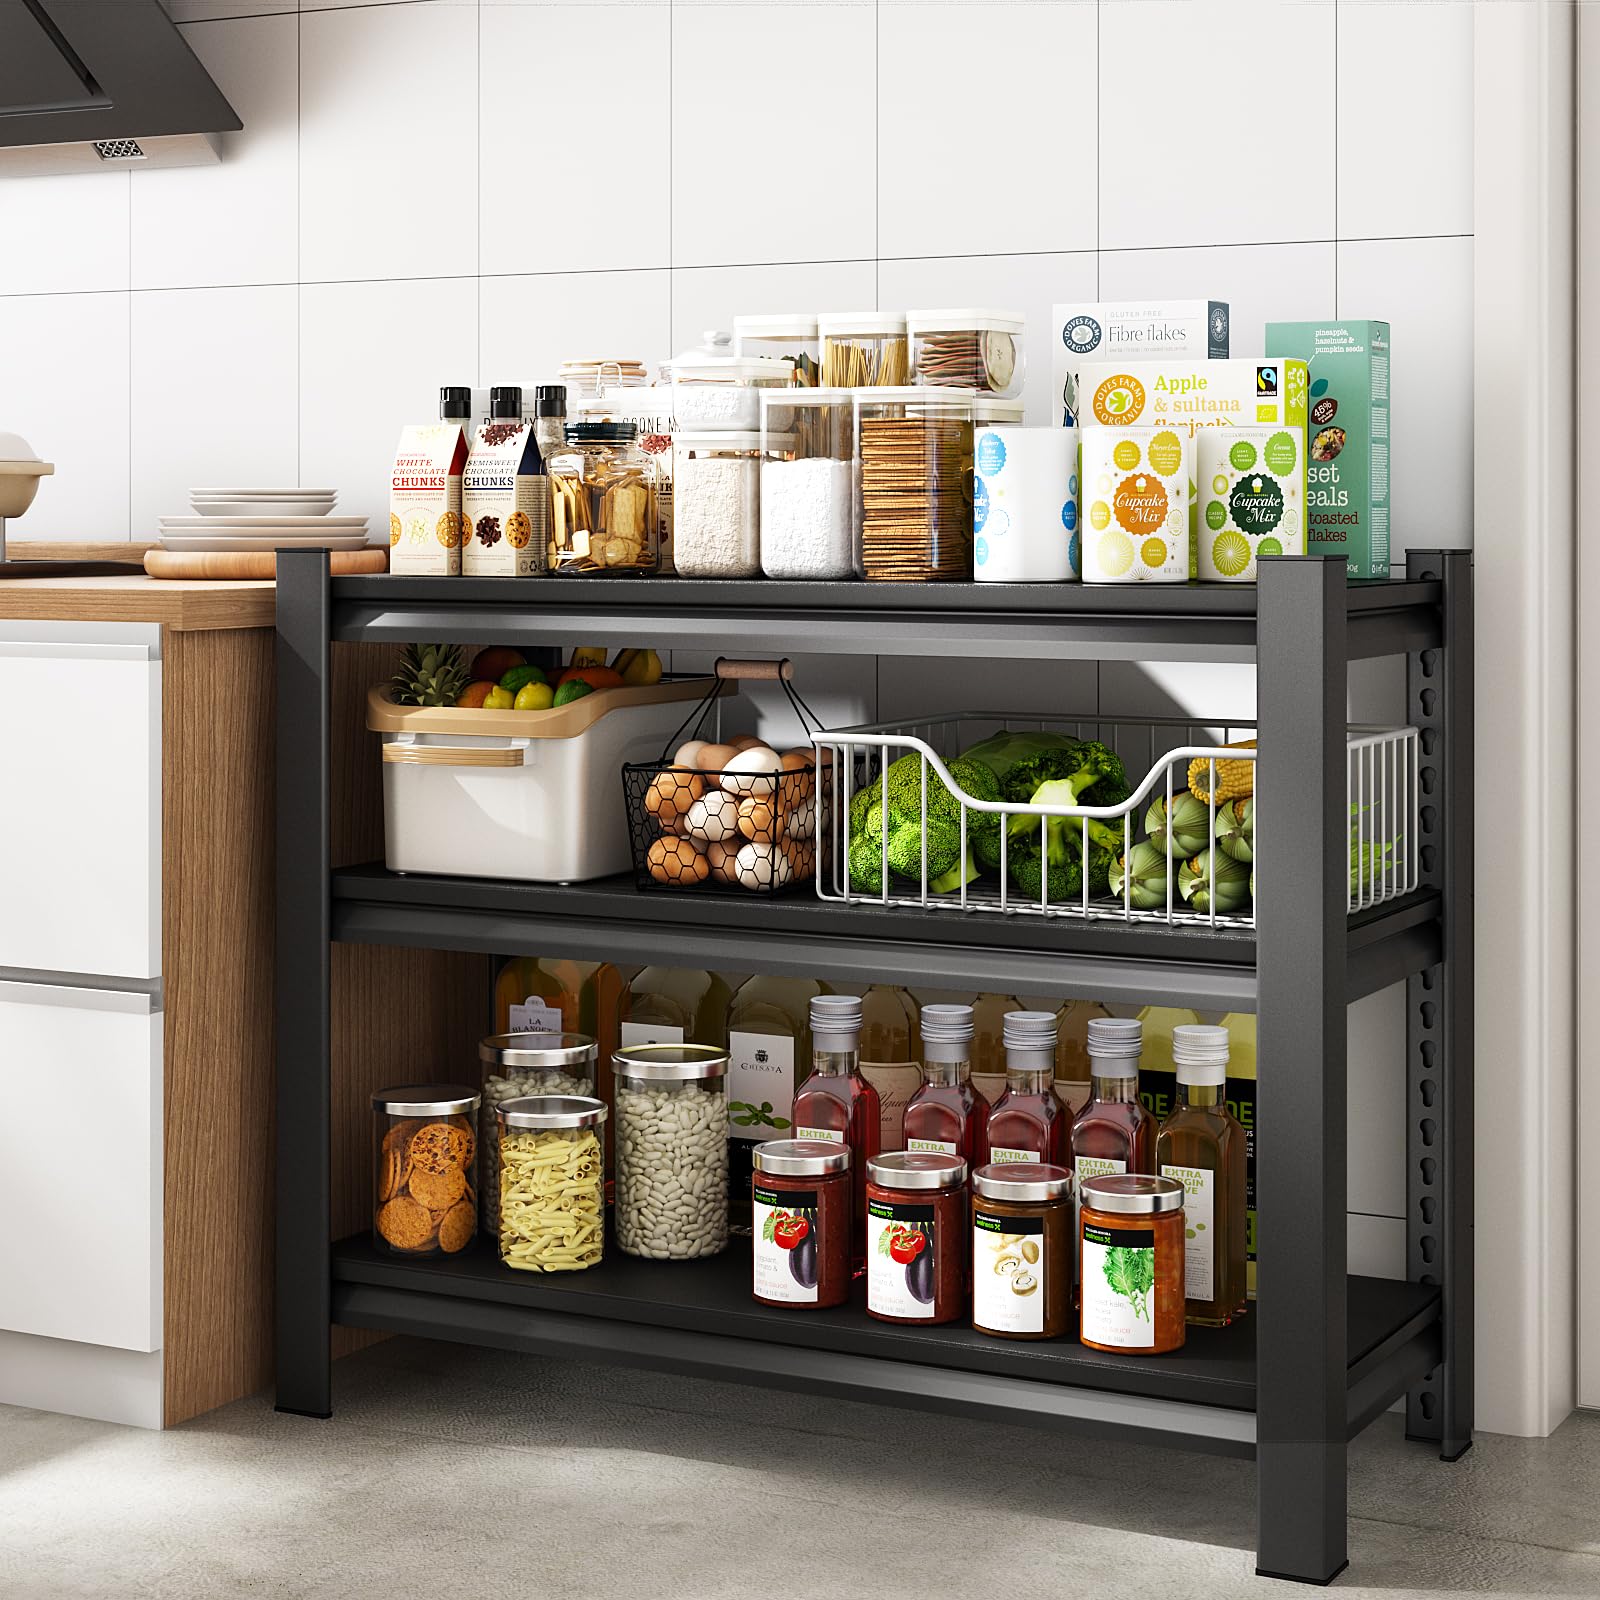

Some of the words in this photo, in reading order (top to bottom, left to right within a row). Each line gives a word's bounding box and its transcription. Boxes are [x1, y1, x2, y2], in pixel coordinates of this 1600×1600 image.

[1064, 317, 1084, 337] DOVES
[1084, 318, 1100, 337] FARM
[1109, 325, 1143, 342] Fibre
[1147, 323, 1187, 341] flakes
[1066, 339, 1099, 352] ORGANIC
[1315, 345, 1345, 354] pumpkin
[1153, 374, 1208, 394] Apple
[1095, 379, 1118, 410] DOVES
[1118, 377, 1144, 399] FARM
[1153, 397, 1168, 413] &
[1172, 397, 1242, 412] sultana
[1099, 402, 1143, 425] ORGANIC
[396, 459, 433, 467] WHITE
[467, 459, 518, 467] SEMISWEET
[392, 477, 446, 487] CHUNKS
[463, 476, 514, 487] CHUNKS
[1116, 492, 1165, 511] Cupcake
[1232, 492, 1281, 511] Cupcake
[1129, 507, 1161, 523] Mix
[1245, 507, 1276, 523] Mix
[1309, 511, 1359, 525] toasted
[1307, 528, 1347, 542] flakes
[529, 1018, 542, 1026] LA
[740, 1062, 783, 1074] CHINATA
[799, 1129, 833, 1139] EXTRA
[911, 1141, 946, 1152] EXTRA
[993, 1150, 1029, 1161] EXTRA
[1078, 1158, 1115, 1170] EXTRA
[1164, 1167, 1202, 1179] EXTRA
